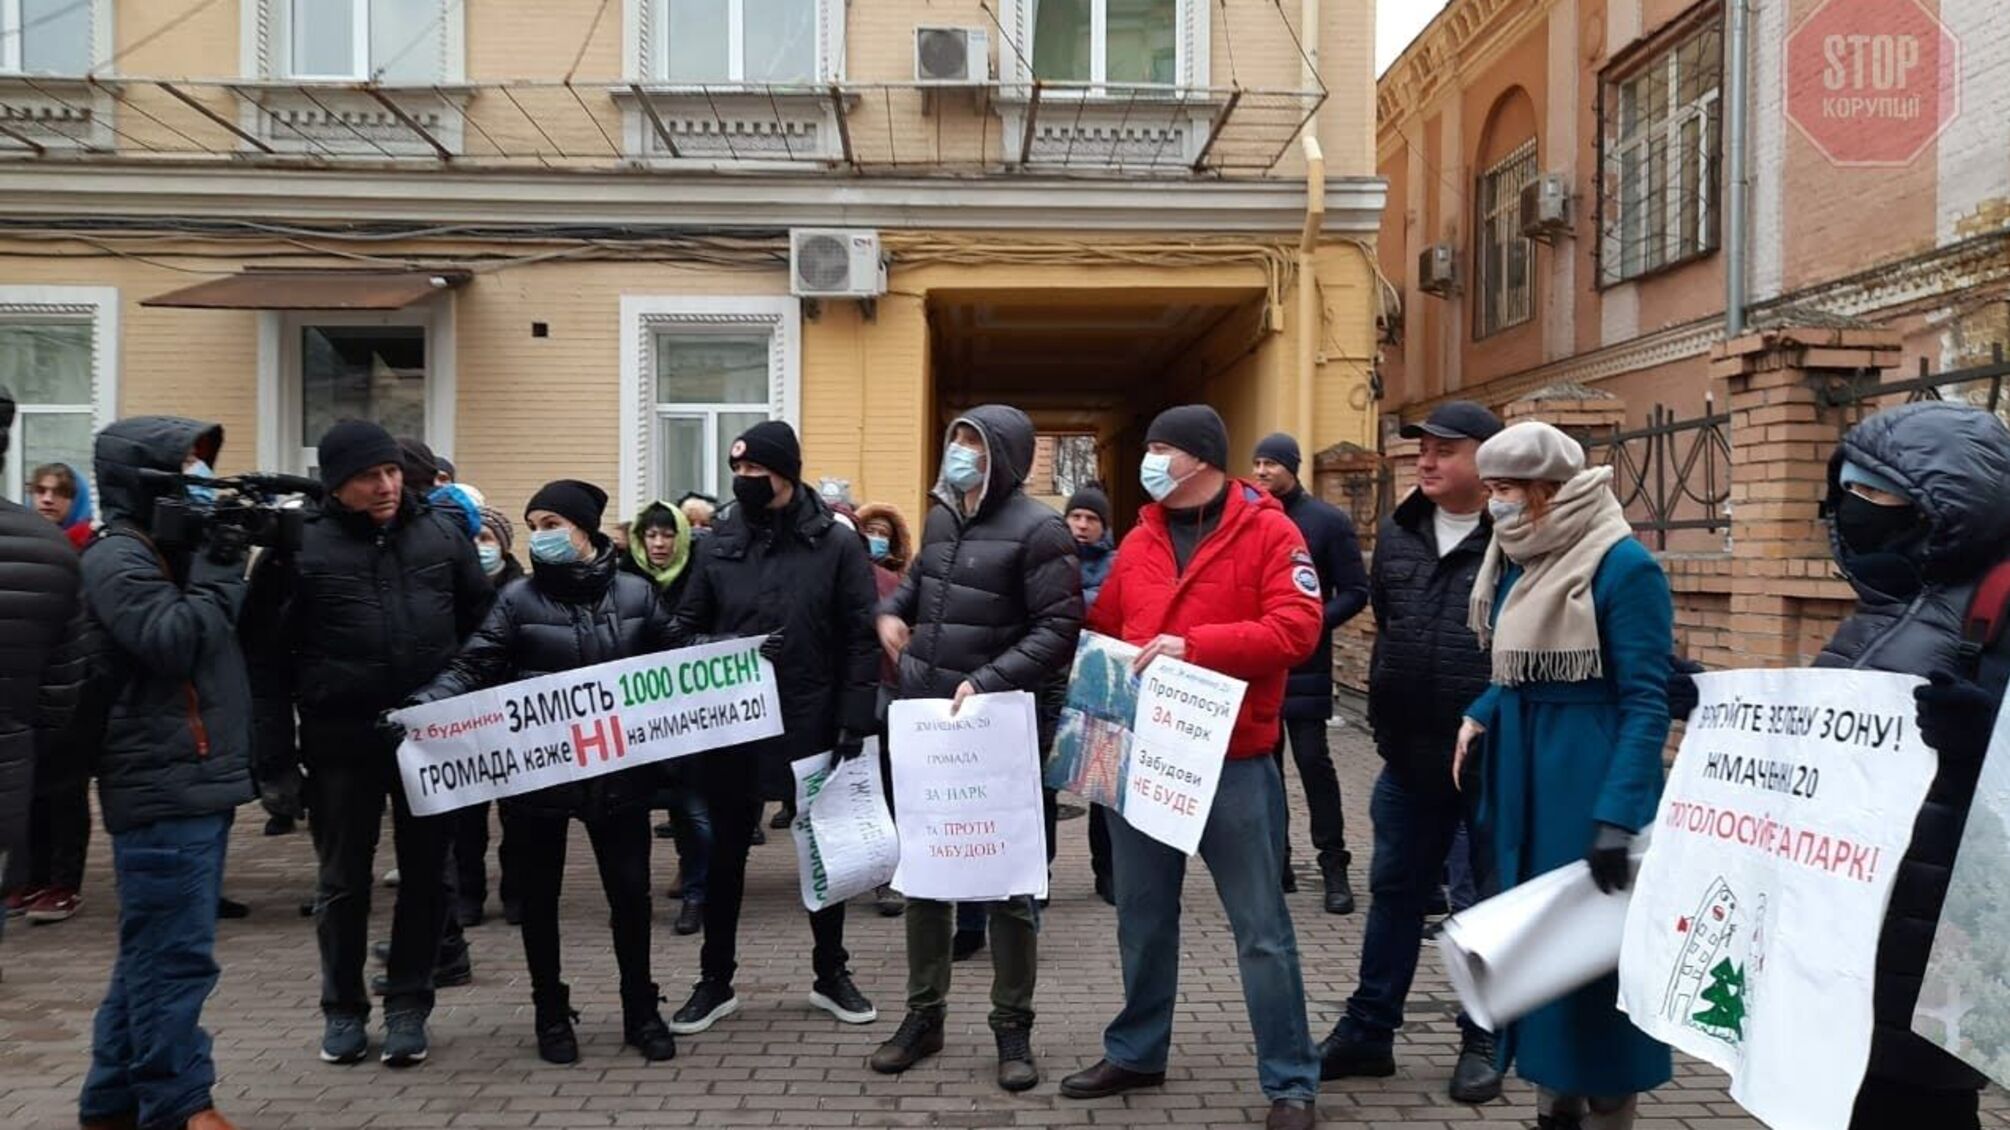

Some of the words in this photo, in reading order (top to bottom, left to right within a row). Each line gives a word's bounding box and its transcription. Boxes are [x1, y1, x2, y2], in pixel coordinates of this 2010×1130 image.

[411, 727, 423, 742] 2
[428, 711, 505, 739] будинки
[505, 681, 615, 733] ЗАМІСТЬ
[619, 666, 673, 707] 1000
[678, 647, 762, 695] СОСЕН!
[1147, 677, 1231, 718] Проголосуй
[1151, 705, 1172, 726] ЗА
[1175, 716, 1211, 742] парк
[1820, 708, 1903, 752] ЗОНУ!
[419, 748, 521, 797] ГРОМАДА
[523, 741, 573, 772] каже
[571, 715, 625, 767] НІ
[627, 725, 646, 746] на
[648, 701, 741, 741] ЖМАЧЕНКА
[740, 693, 767, 722] 20!
[1139, 749, 1202, 788] Забудови
[1791, 764, 1820, 799] 20
[1132, 774, 1151, 798] НЕ
[1153, 784, 1199, 816] БУДЕ
[943, 821, 997, 836] ПРОТИ
[1793, 830, 1881, 883] ПАРК!
